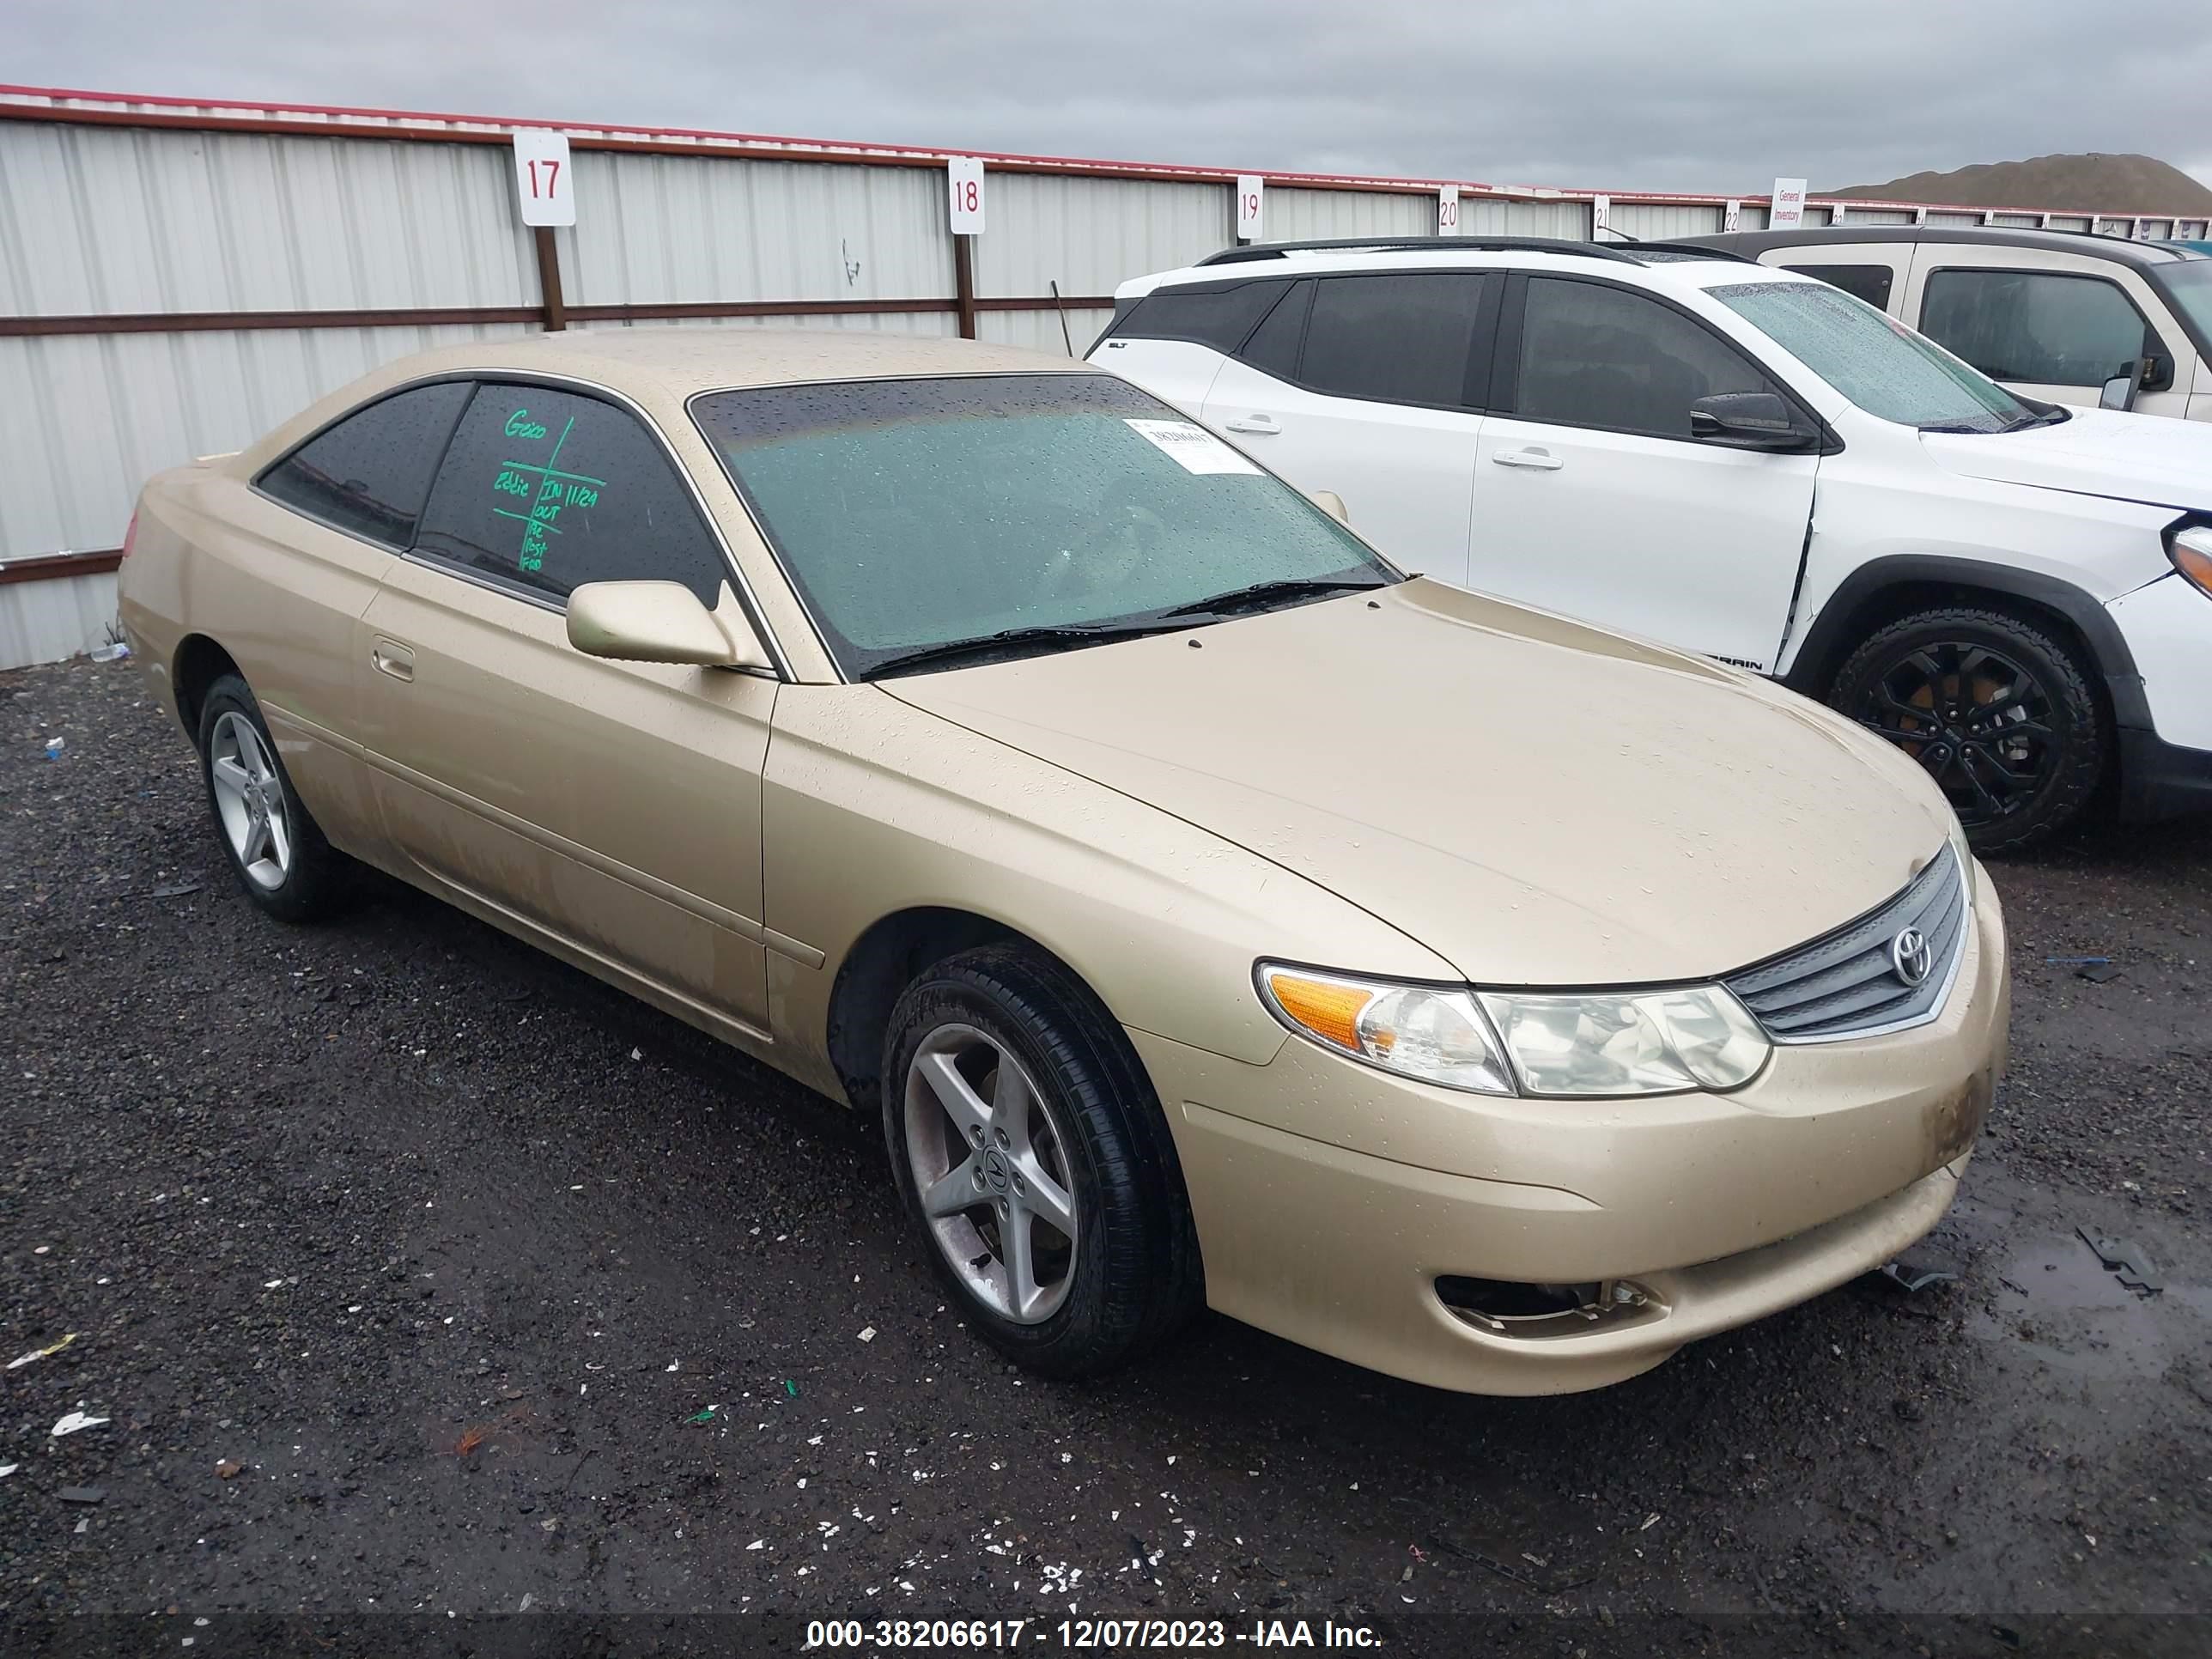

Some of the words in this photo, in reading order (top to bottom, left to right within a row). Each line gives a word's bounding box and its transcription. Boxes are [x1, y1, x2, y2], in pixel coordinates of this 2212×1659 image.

[528, 160, 560, 198] 17
[957, 181, 978, 212] 18
[1243, 194, 1258, 220] 19
[1441, 202, 1456, 226] 20
[1597, 208, 1607, 229] 21
[1726, 212, 1738, 232] 22
